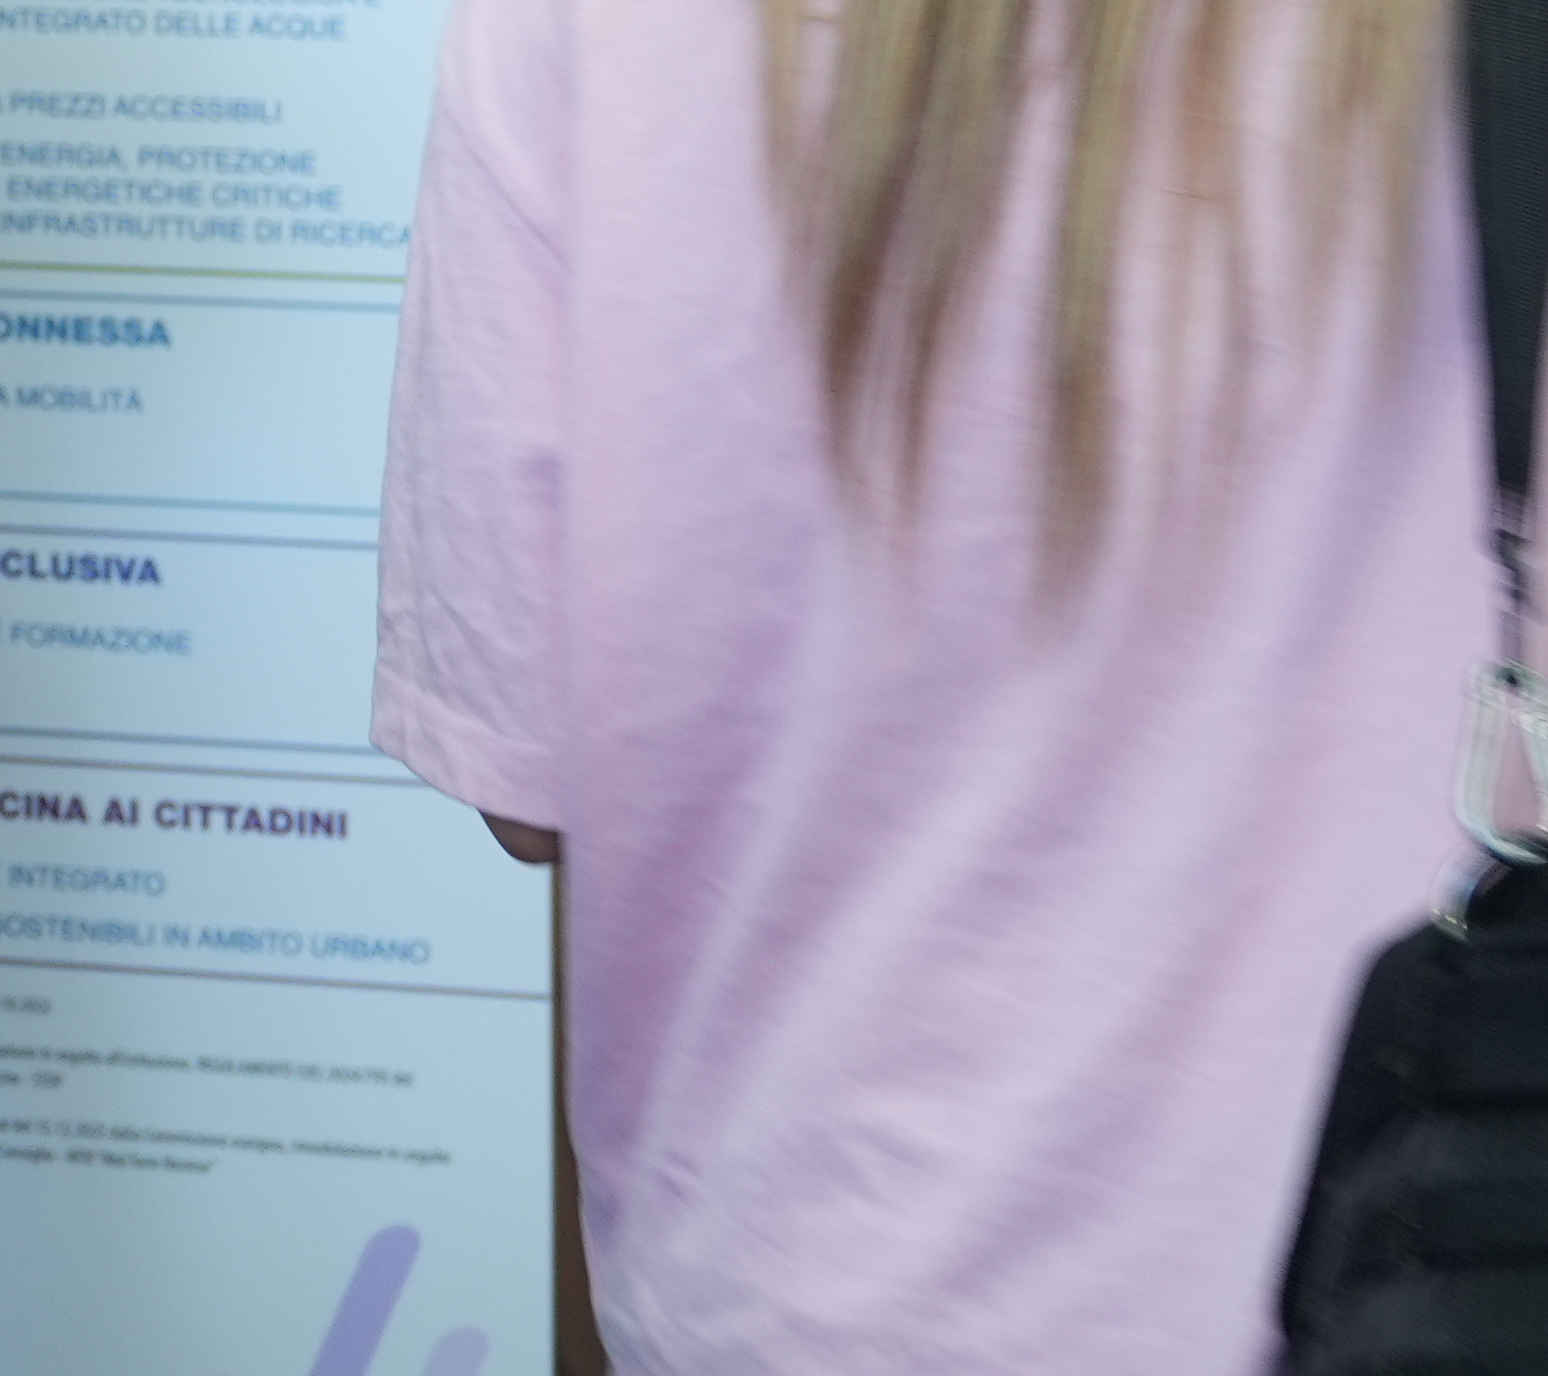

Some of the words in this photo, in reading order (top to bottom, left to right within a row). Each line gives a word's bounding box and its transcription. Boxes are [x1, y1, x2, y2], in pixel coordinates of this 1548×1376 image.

[154, 10, 242, 38] DELLE
[249, 13, 346, 43] ACQUE
[9, 90, 106, 120] PREZZI
[113, 93, 285, 125] ACCESSIBILI
[138, 143, 317, 176] PROTEZIONE
[7, 173, 201, 208] ENERGETICHE
[212, 181, 343, 213] CRITICHE
[0, 208, 245, 245] INFRASTRUTTURE
[255, 216, 283, 245] DI
[9, 619, 194, 656] FORMAZIONE
[102, 797, 140, 828] AI
[155, 800, 349, 840] CITTADINI
[8, 857, 167, 897] INTEGRATO
[162, 922, 190, 948] IN
[197, 924, 303, 957] AMBITO
[311, 931, 431, 966] URBANO
